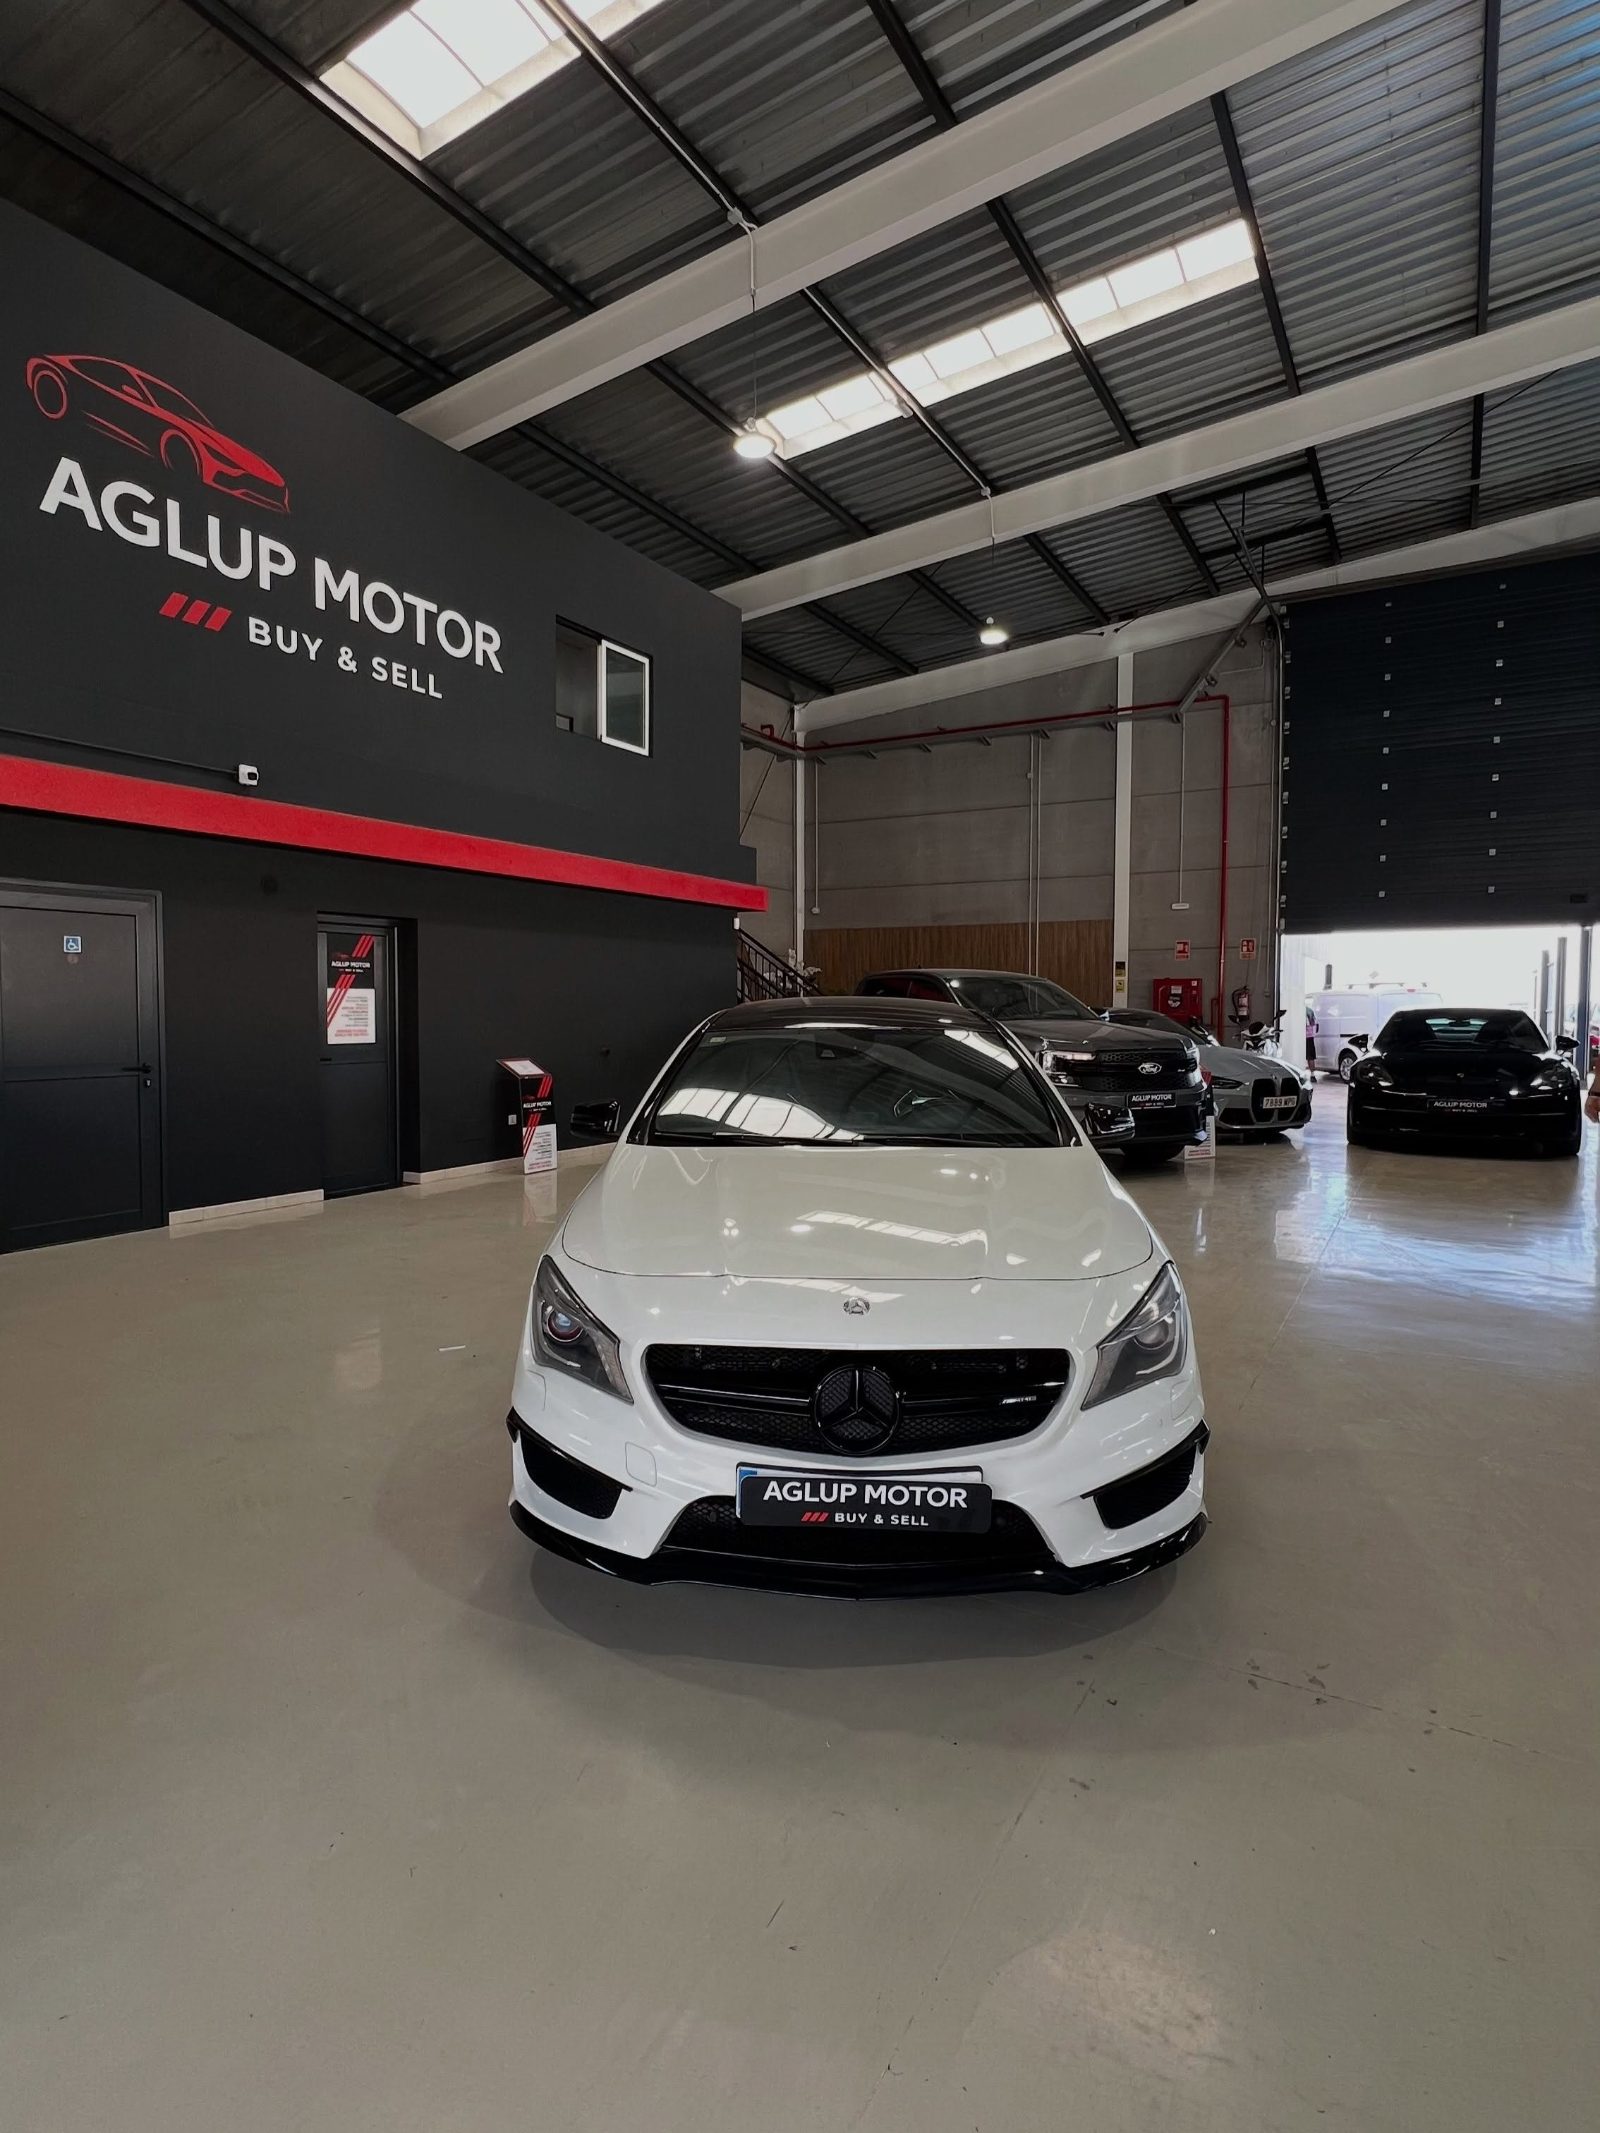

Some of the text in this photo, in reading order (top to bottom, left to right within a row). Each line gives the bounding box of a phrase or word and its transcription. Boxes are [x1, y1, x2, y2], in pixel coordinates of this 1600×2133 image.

[39, 456, 504, 674] AGLUP MOTOR
[248, 616, 443, 699] BUY & SELL
[763, 1480, 968, 1509] AGLUP MOTOR
[834, 1512, 929, 1526] BUY & SELL
